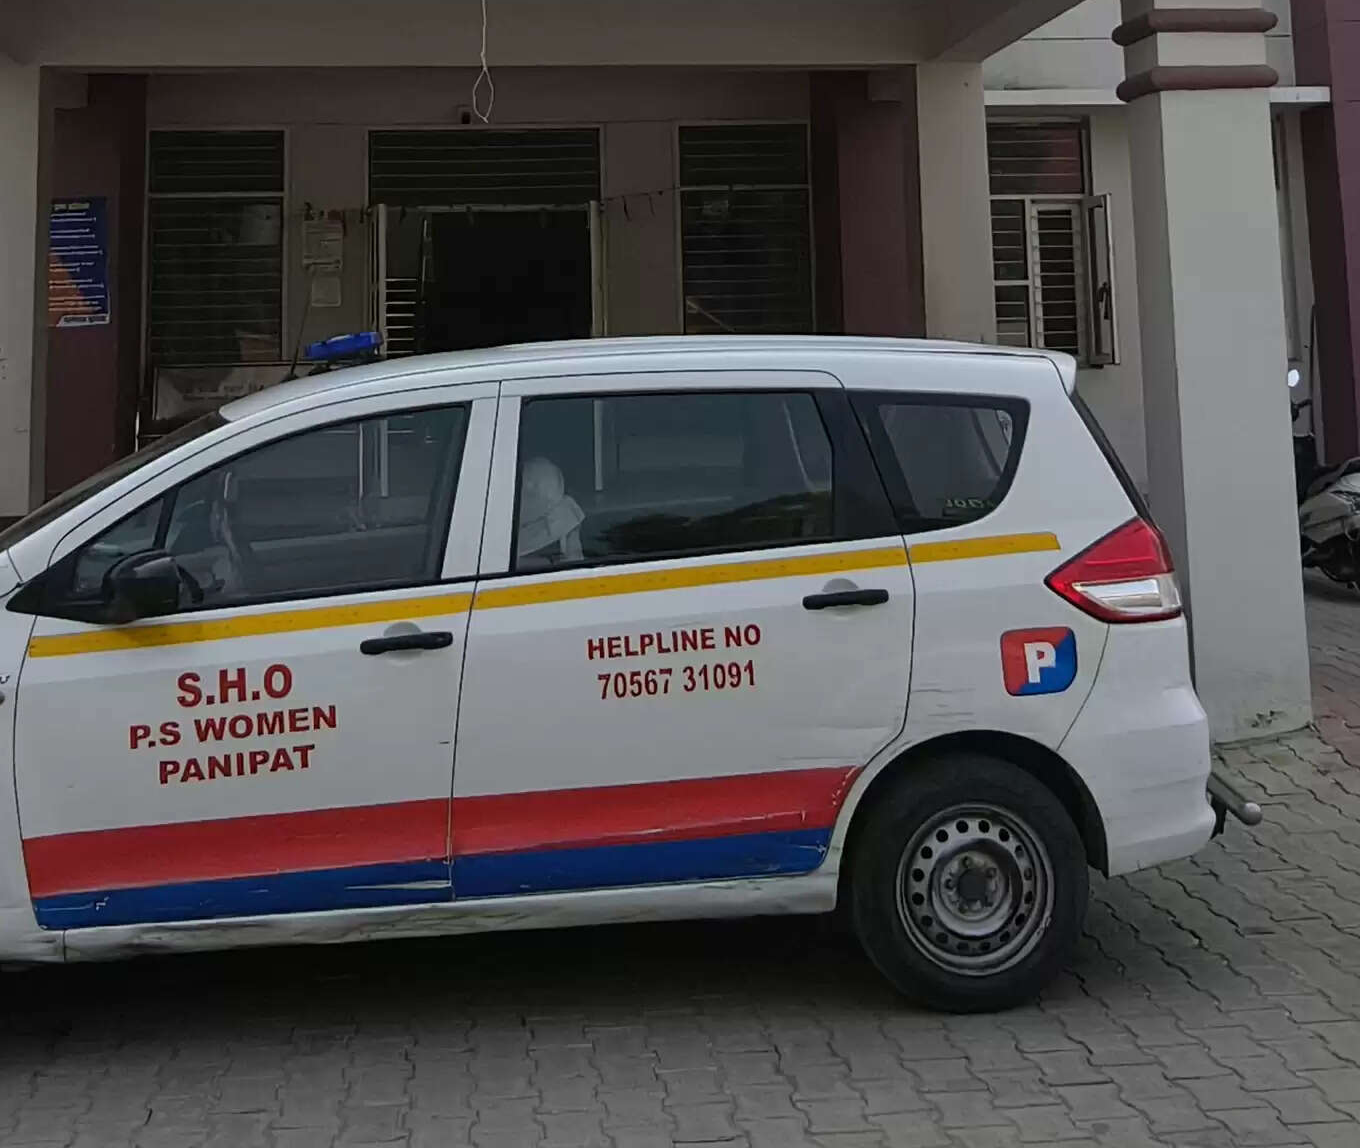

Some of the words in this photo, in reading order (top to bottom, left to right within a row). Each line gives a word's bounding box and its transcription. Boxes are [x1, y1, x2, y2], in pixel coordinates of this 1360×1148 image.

[586, 626, 716, 661] HELPLINE
[724, 623, 761, 648] NO
[176, 663, 293, 708] S.H.O
[597, 667, 672, 700] 70567
[682, 659, 757, 693] 31091
[129, 720, 182, 750] P.S
[194, 704, 338, 743] WOMEN
[159, 743, 315, 785] PANIPAT
